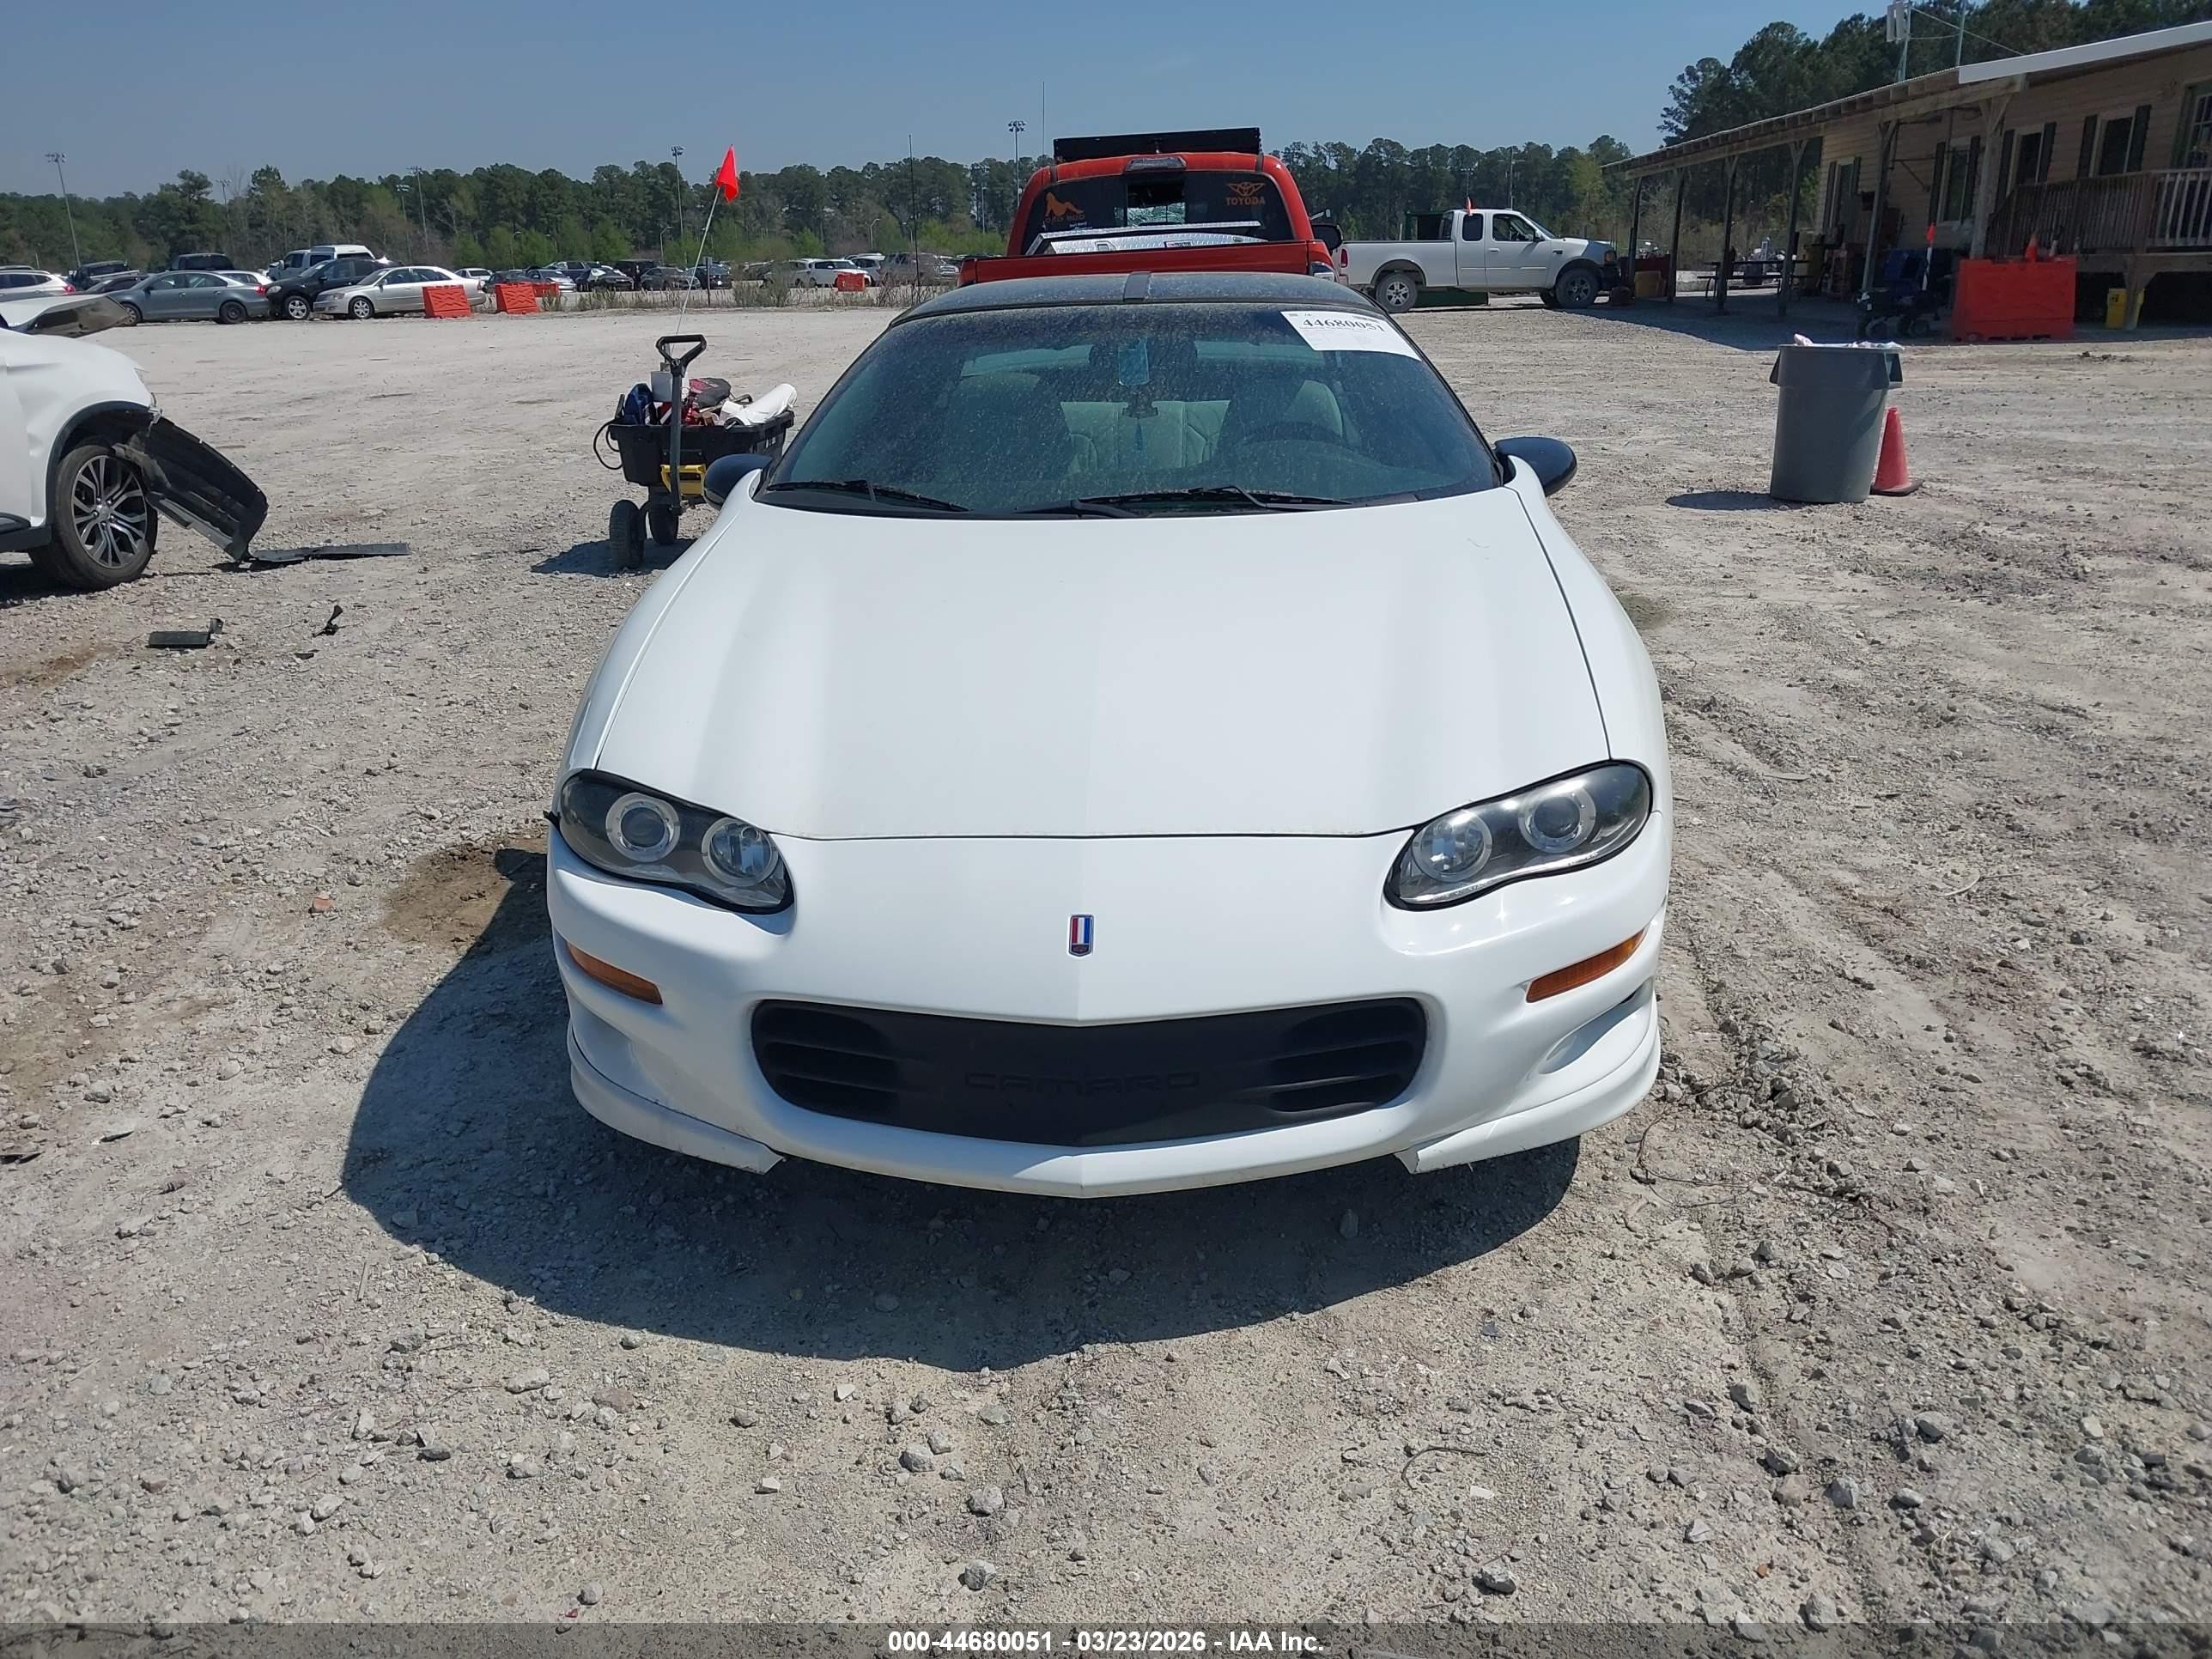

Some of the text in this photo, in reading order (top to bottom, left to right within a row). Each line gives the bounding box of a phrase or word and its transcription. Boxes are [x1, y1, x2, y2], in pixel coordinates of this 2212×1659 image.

[1225, 197, 1266, 206] TOYODA
[1303, 319, 1385, 332] 44680051
[963, 1072, 1200, 1096] CAMARO
